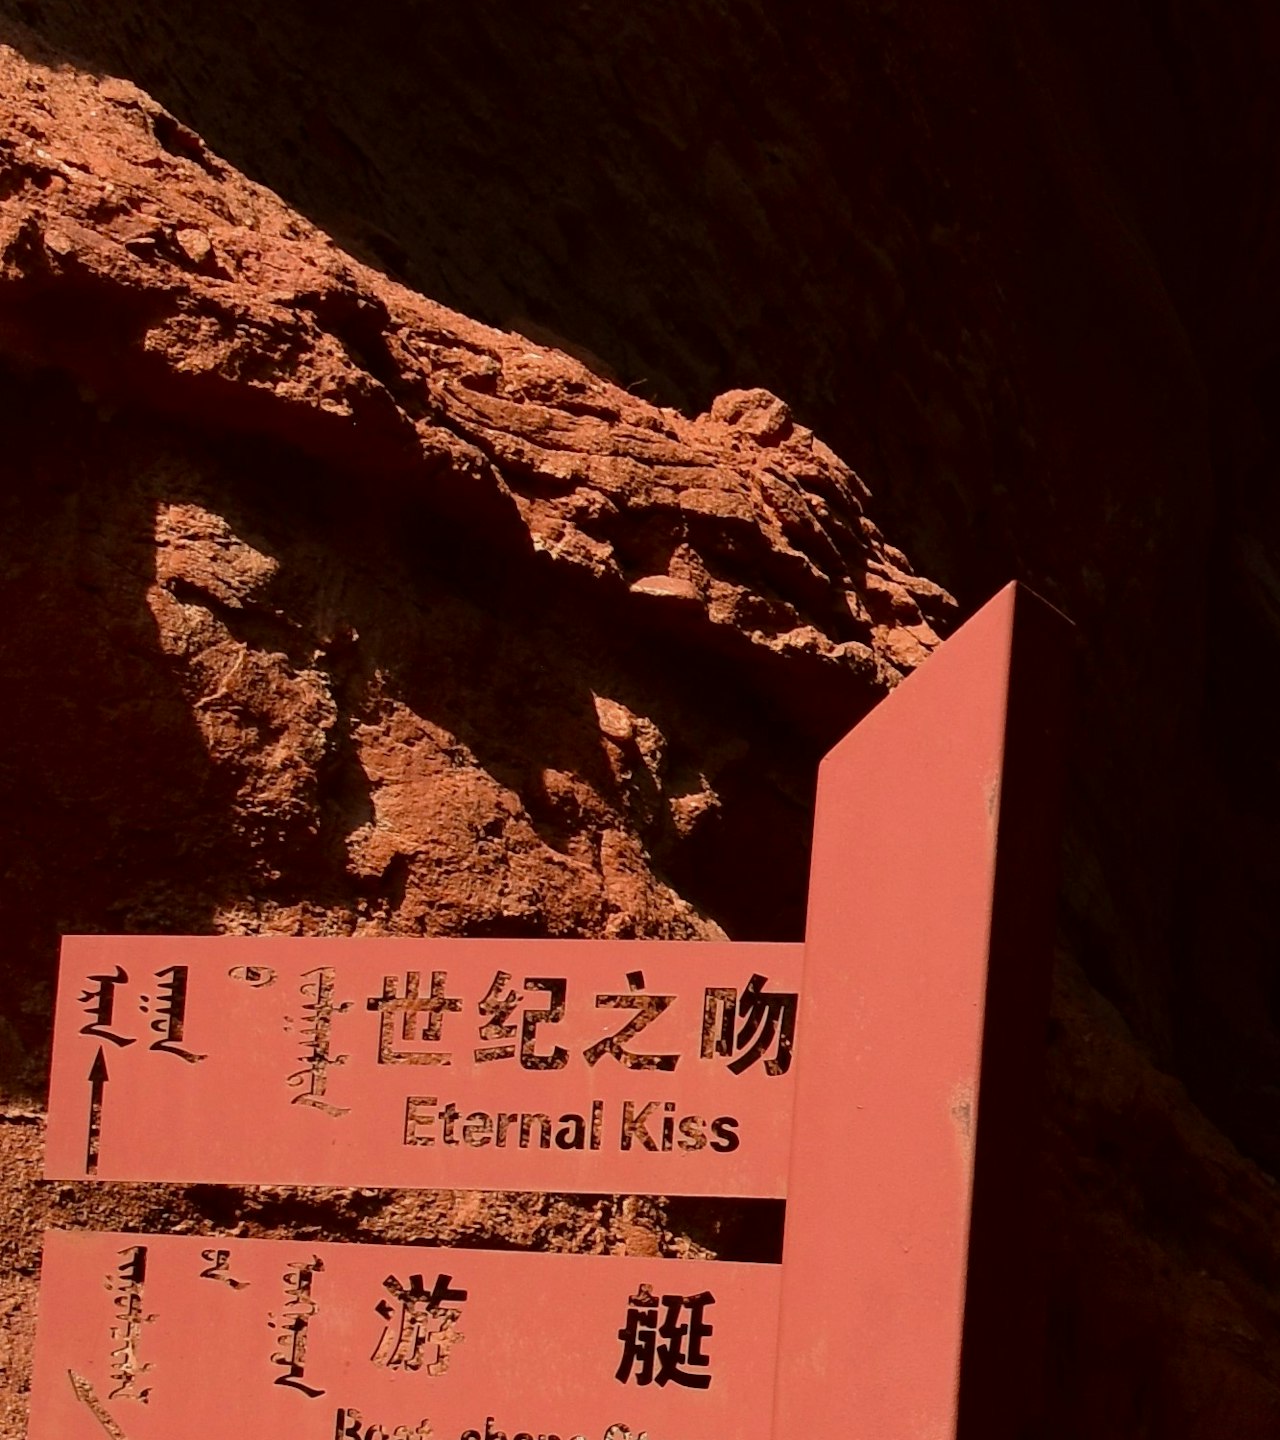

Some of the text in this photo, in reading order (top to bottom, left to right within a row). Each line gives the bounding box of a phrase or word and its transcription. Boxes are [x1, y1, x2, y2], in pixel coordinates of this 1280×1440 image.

[366, 970, 798, 1077] 世纪之吻
[404, 1096, 740, 1153] Eternal Kiss
[370, 1273, 715, 1389] 游艇
